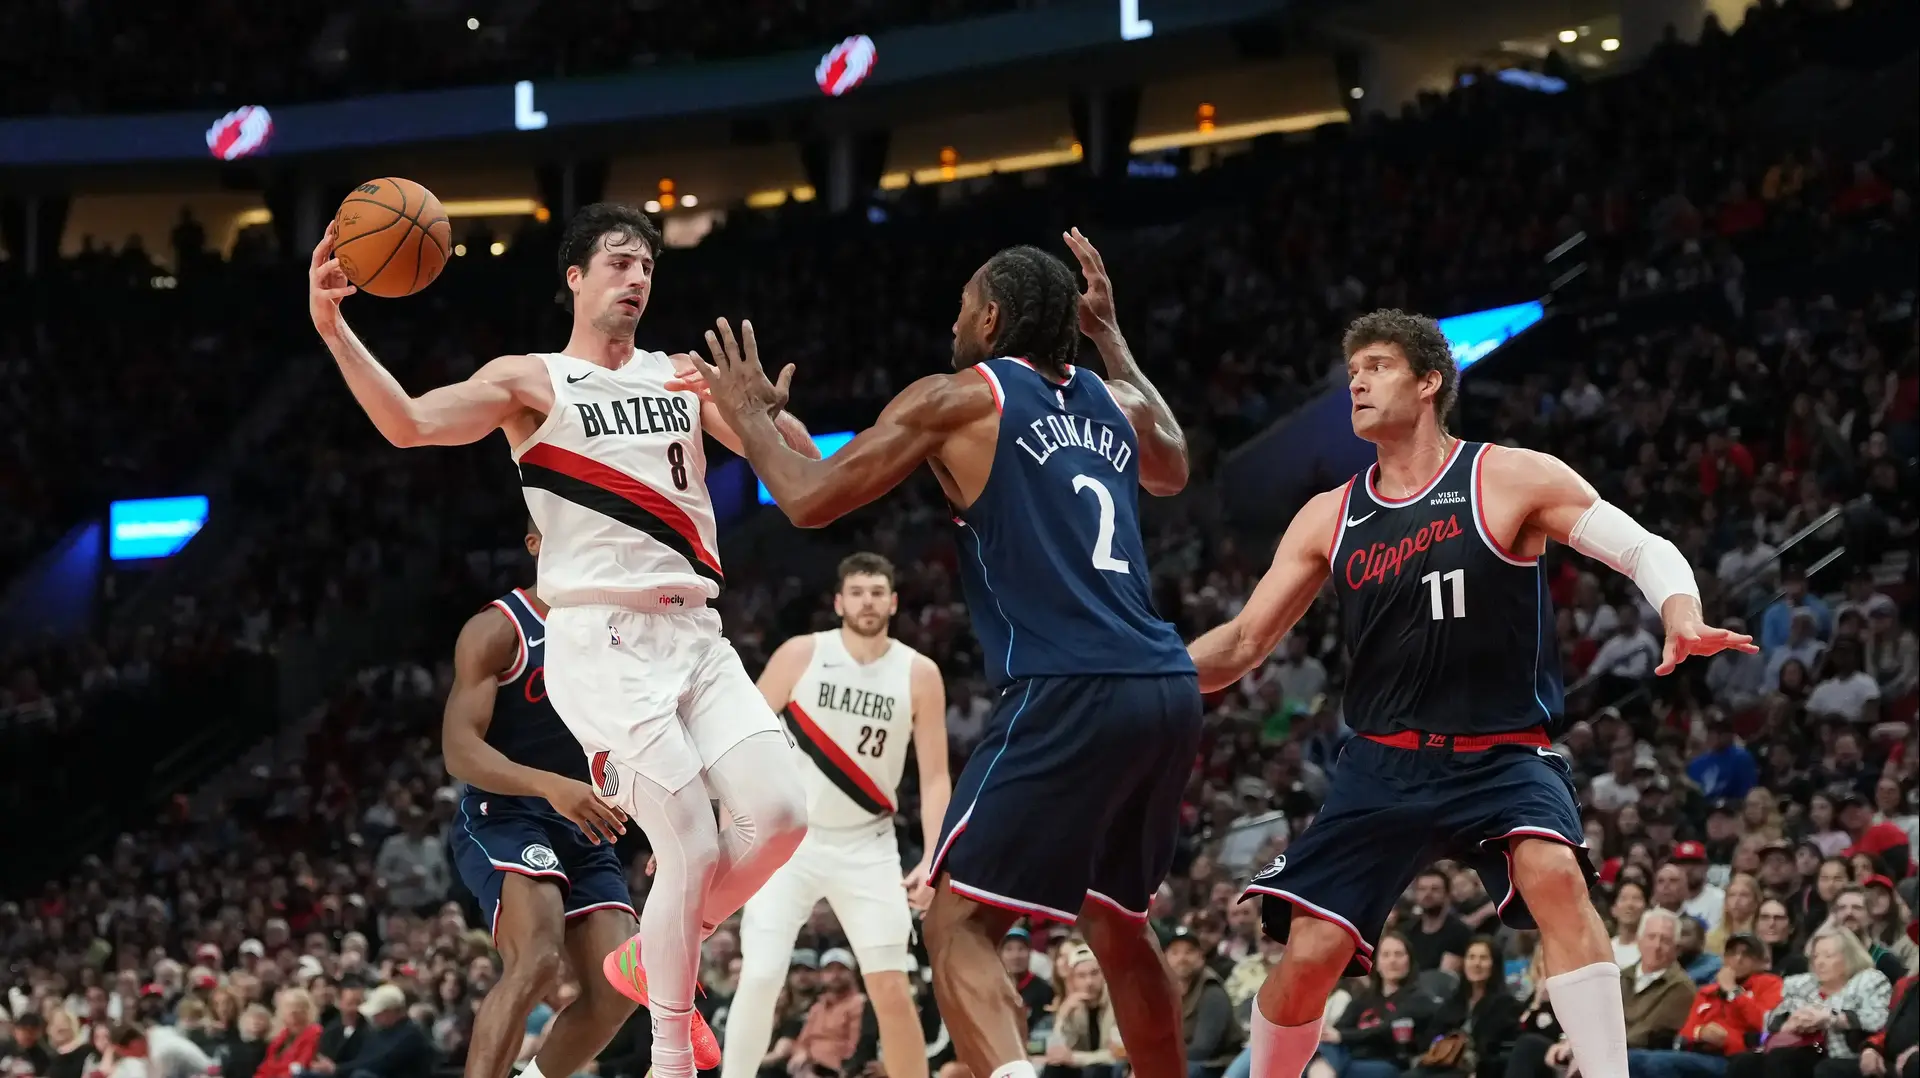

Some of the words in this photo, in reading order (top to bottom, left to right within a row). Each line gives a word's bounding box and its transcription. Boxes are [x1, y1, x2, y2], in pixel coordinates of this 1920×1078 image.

[1120, 0, 1153, 41] L
[515, 80, 548, 130] L
[573, 396, 691, 438] BLAZERS
[667, 441, 689, 491] 8
[1015, 414, 1132, 473] LEONARD
[1071, 473, 1131, 574] 2
[1430, 496, 1467, 506] RWANDA
[1345, 513, 1464, 591] Clippers
[659, 594, 685, 607] ripcity
[1421, 568, 1466, 621] 11
[817, 682, 896, 722] BLAZERS
[857, 725, 888, 758] 23
